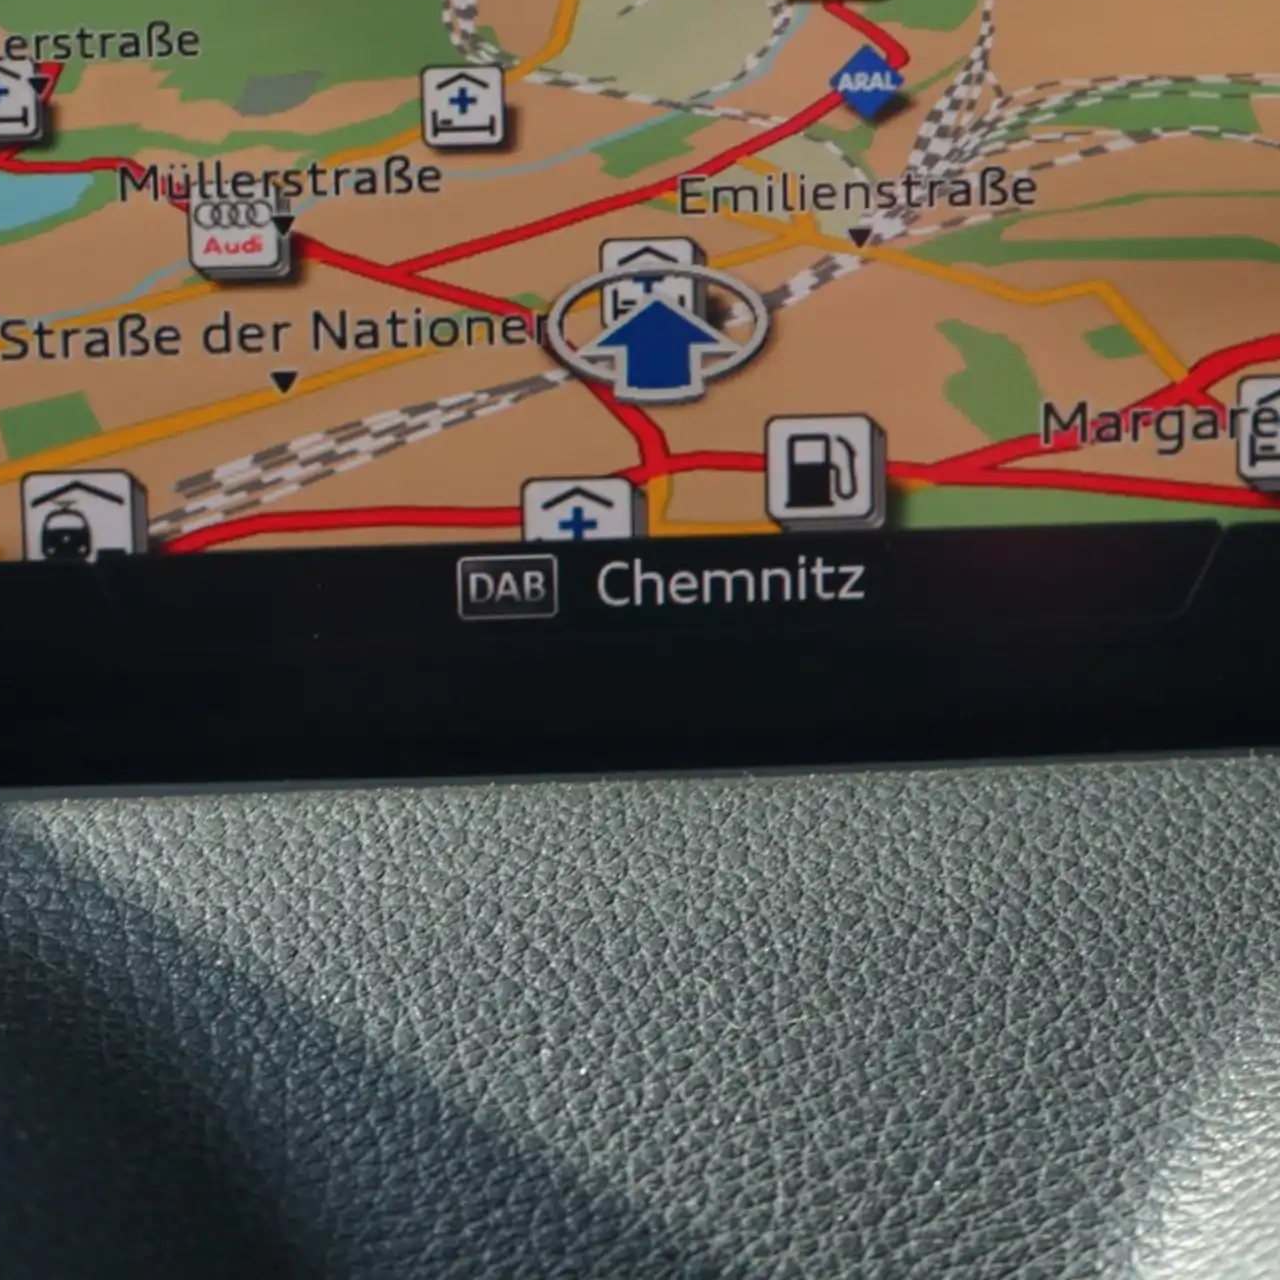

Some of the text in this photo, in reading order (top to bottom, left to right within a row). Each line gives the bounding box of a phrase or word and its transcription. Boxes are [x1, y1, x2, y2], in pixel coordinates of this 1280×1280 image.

[838, 72, 897, 93] ARAL
[120, 156, 442, 203] Müllerstraße
[679, 167, 1037, 214] Emilienstraße
[203, 235, 264, 255] Audi
[1, 313, 181, 361] Straße
[204, 310, 291, 354] der
[468, 570, 547, 604] DAB
[596, 557, 866, 608] Chemnitz
